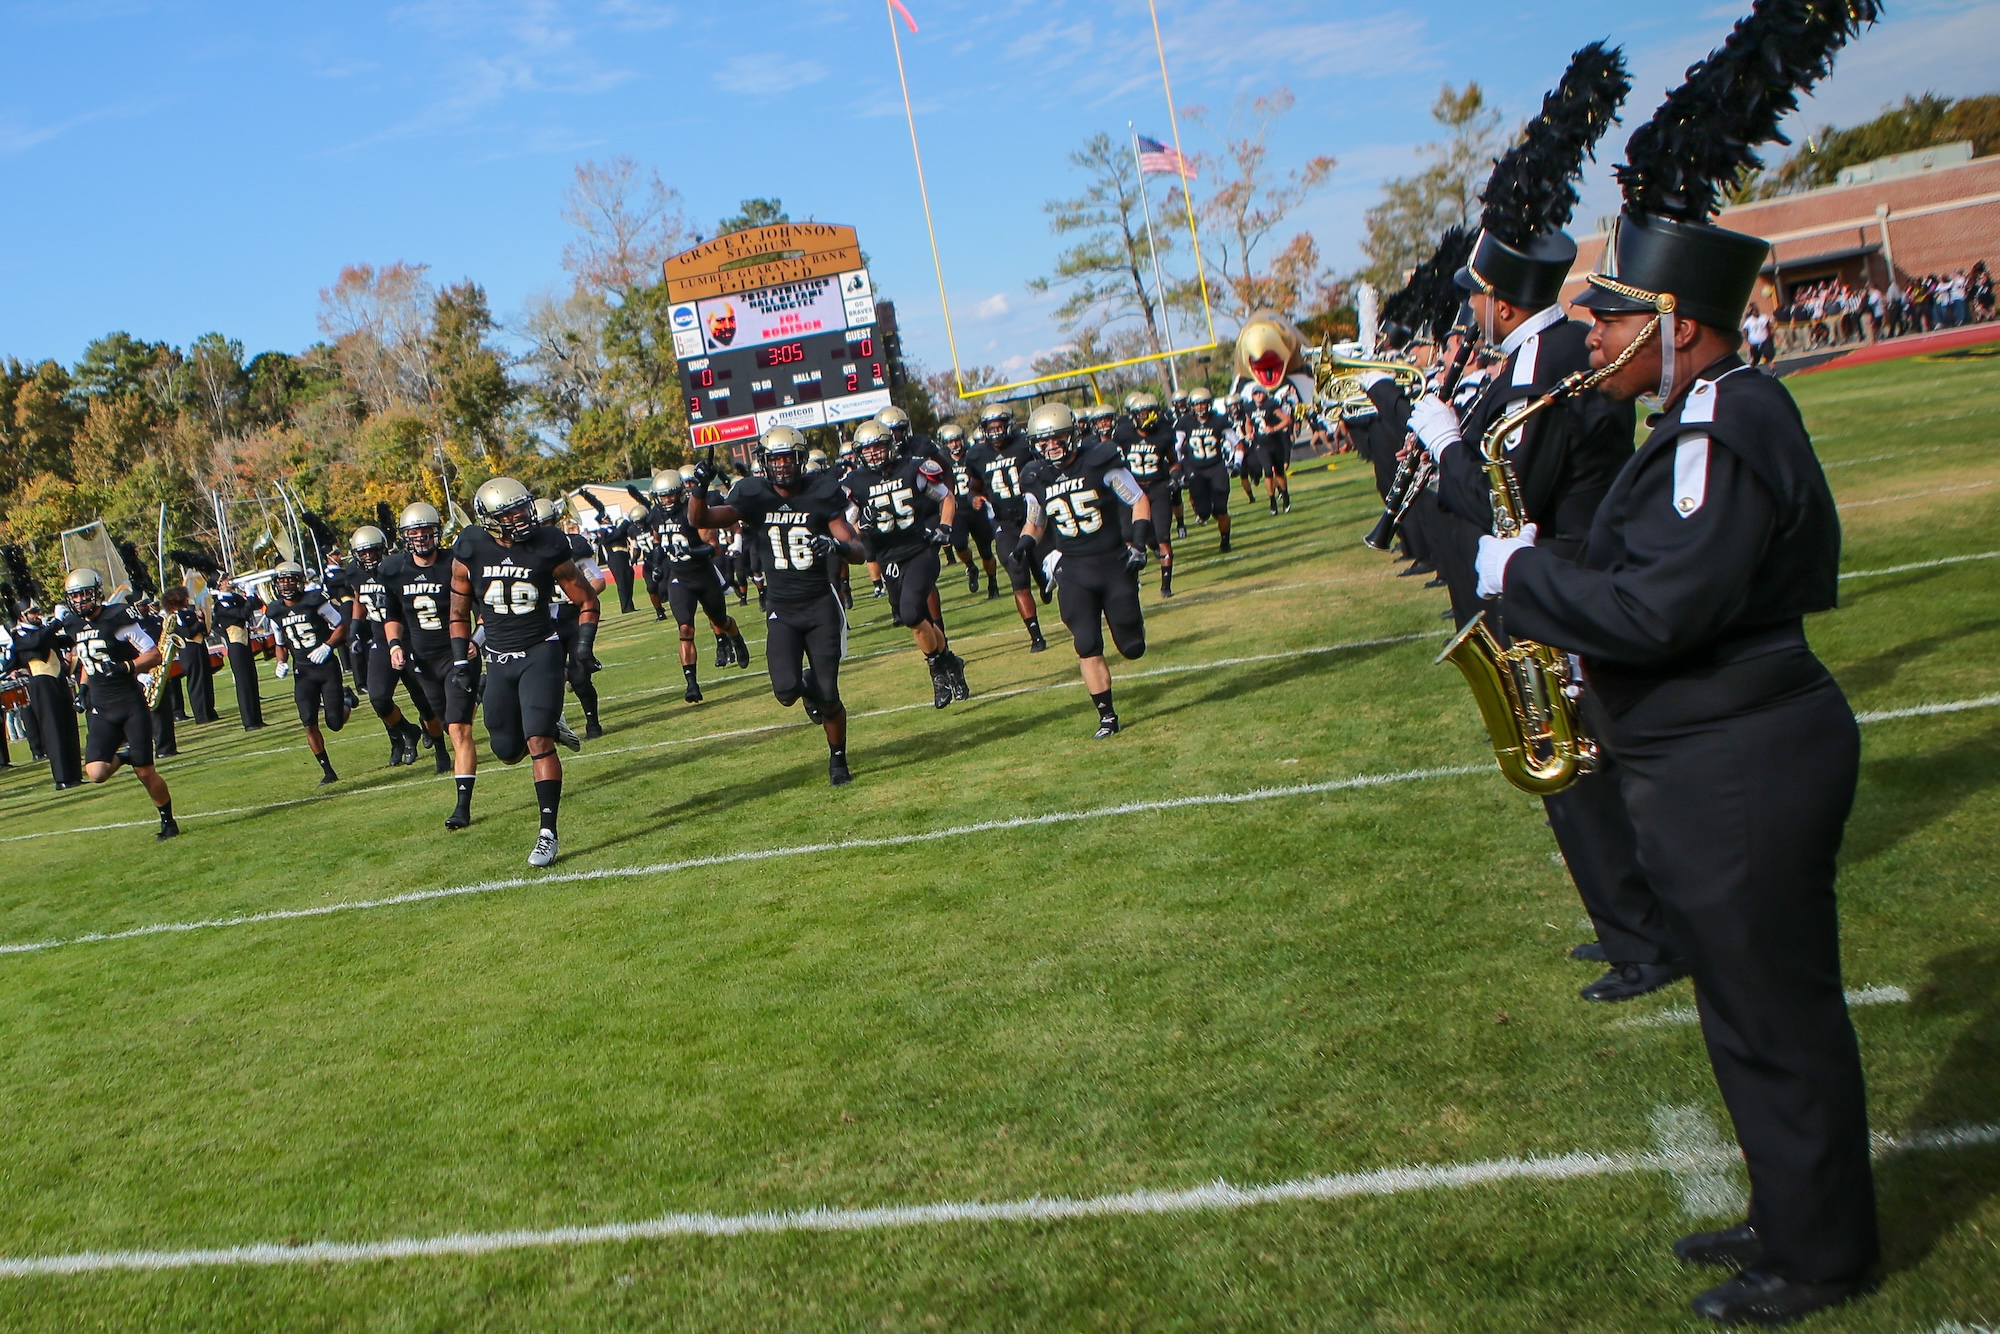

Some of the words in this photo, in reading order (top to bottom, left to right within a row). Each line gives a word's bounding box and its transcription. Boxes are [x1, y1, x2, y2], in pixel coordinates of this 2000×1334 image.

[680, 237, 734, 265] GRACE
[740, 233, 752, 244] P.
[759, 226, 837, 242] JOHNSON
[727, 238, 792, 259] STADIUM
[680, 272, 734, 289] LUMBEE
[738, 258, 807, 278] GUARANTY
[812, 250, 847, 263] BANK
[740, 290, 768, 302] 2013
[771, 279, 830, 297] ATHLETICS
[749, 297, 778, 309] HALL
[779, 295, 792, 303] OF
[795, 288, 824, 300] FAME
[760, 299, 815, 315] INDUCTEE
[848, 307, 873, 317] BRAVES
[845, 328, 872, 341] GUEST
[768, 343, 803, 365] 3:05
[861, 339, 873, 357] 0
[688, 358, 710, 371] UNCP
[842, 364, 857, 374] QTR
[872, 363, 881, 377] 3
[701, 369, 713, 386] 0
[792, 372, 810, 383] BALL
[810, 370, 822, 380] ON
[847, 374, 857, 391] 2
[872, 377, 884, 386] TOL
[708, 388, 730, 399] DOWN
[751, 381, 761, 391] TO
[761, 380, 772, 389] GO
[691, 397, 700, 411] 3
[691, 411, 703, 419] TOL
[779, 407, 814, 419] metcon
[1189, 436, 1218, 459] 92
[985, 457, 1017, 473] BRAVES
[1127, 452, 1158, 475] 22
[868, 478, 903, 497] BRAVES
[954, 473, 969, 495] 2
[991, 466, 1021, 499] 41
[1045, 477, 1086, 500] BRAVES
[764, 512, 811, 524] BRAVES
[868, 487, 915, 533] 55
[1045, 489, 1103, 537] 35
[482, 566, 533, 579] BRAVES
[403, 583, 443, 596] BRAVES
[483, 580, 539, 615] 49
[281, 614, 307, 627] BRAVES
[413, 595, 442, 630] 2
[285, 622, 317, 649] 15
